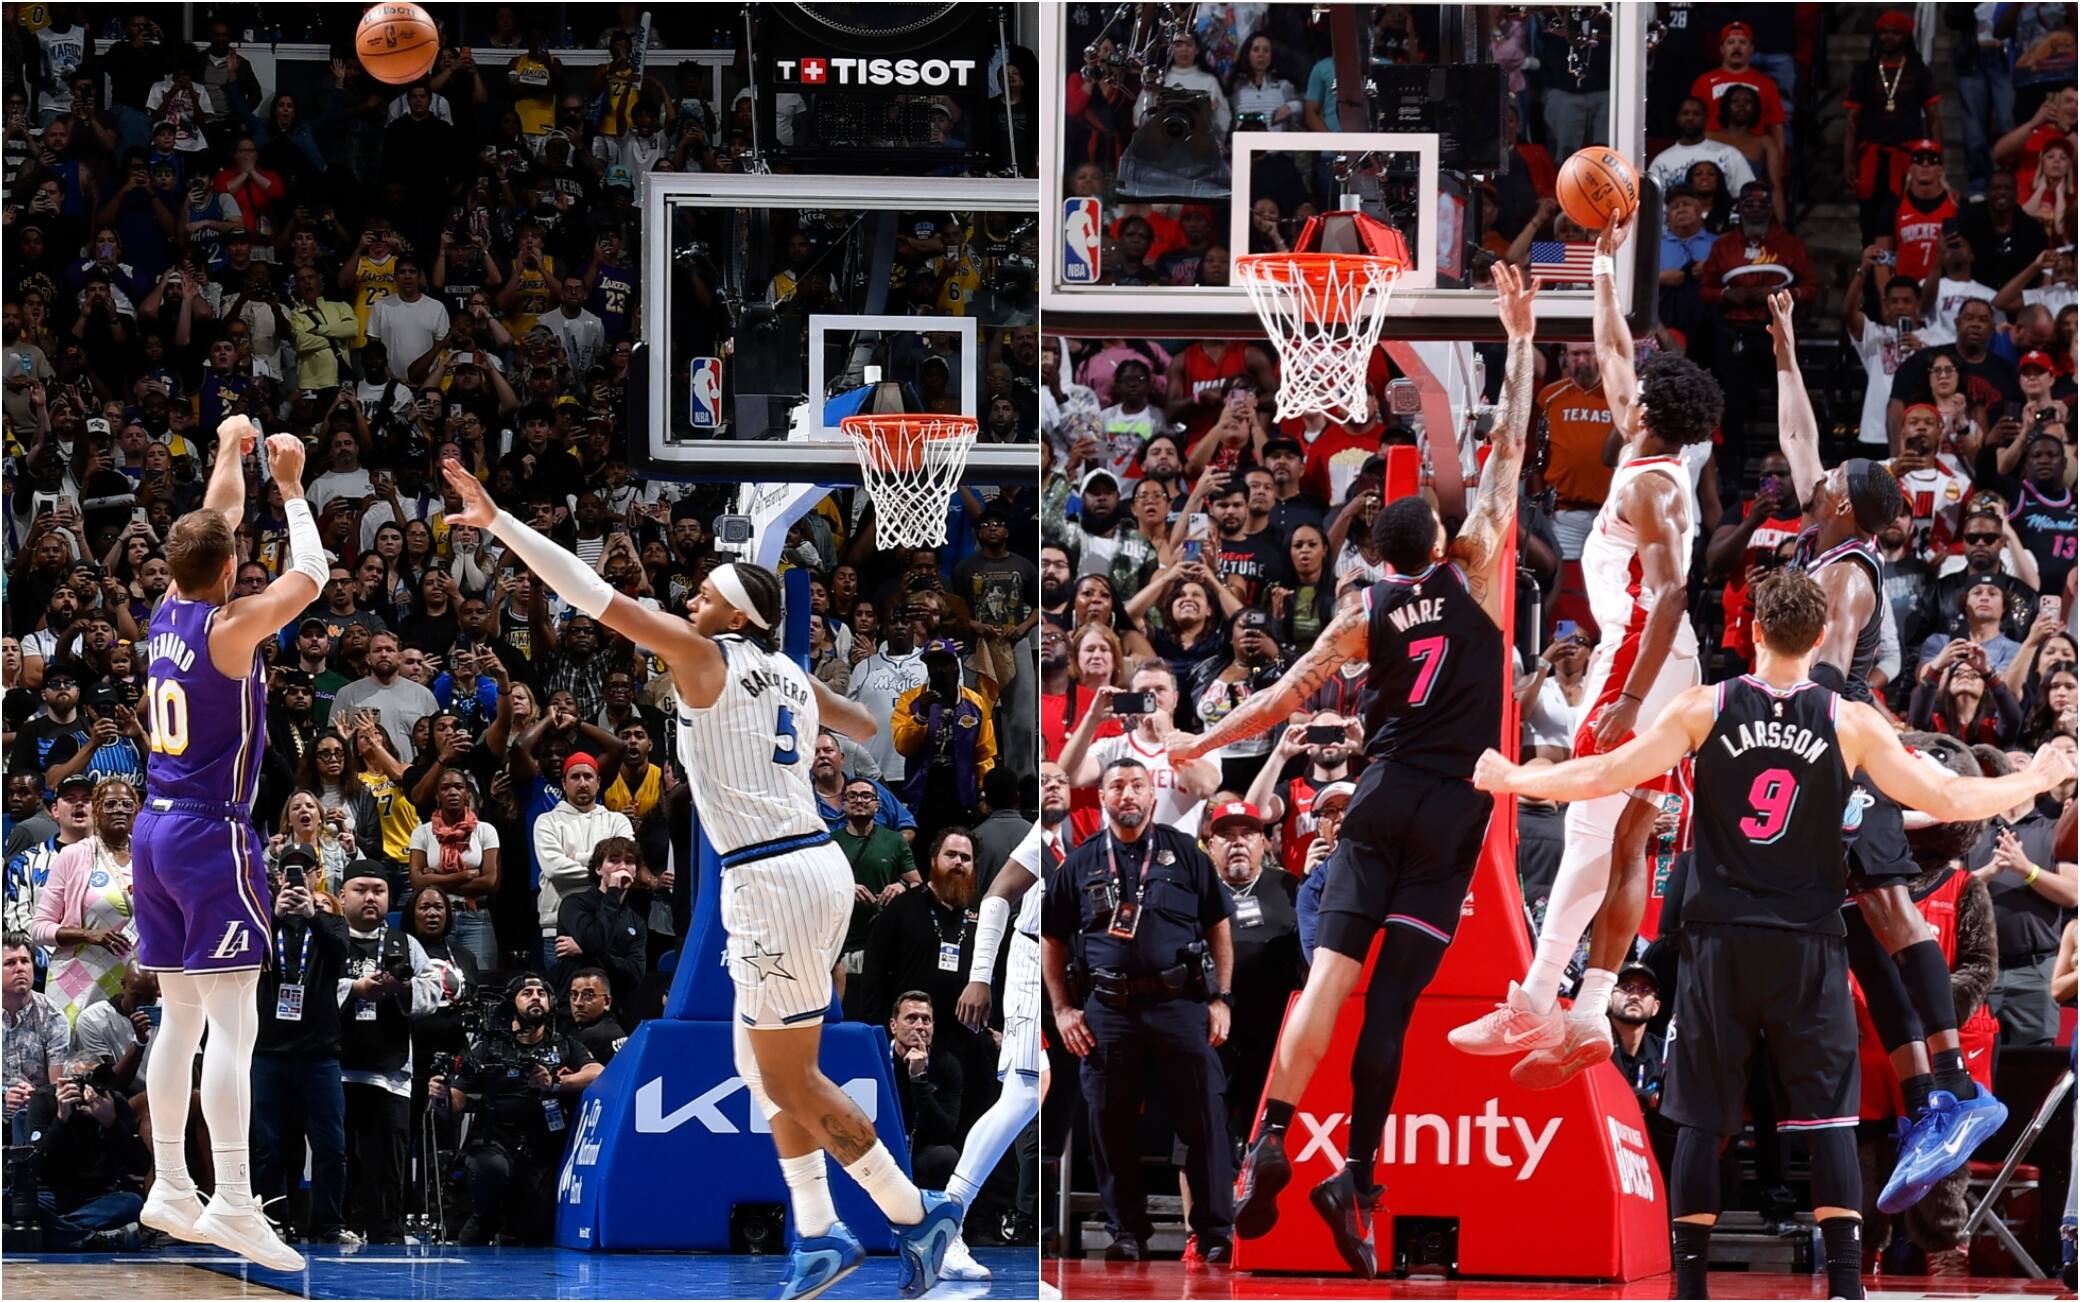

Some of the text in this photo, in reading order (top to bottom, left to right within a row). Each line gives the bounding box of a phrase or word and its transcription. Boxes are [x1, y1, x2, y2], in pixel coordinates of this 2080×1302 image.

[1669, 9, 1688, 29] 28
[831, 58, 976, 86] TISSOT
[1900, 222, 1943, 244] ROCKET
[1920, 243, 1932, 267] 7
[1067, 262, 1086, 279] NBA
[522, 295, 548, 315] 23
[949, 282, 961, 301] 6
[693, 410, 711, 424] NBA
[1562, 408, 1612, 425] TEXAS
[2051, 532, 2078, 559] 13
[1218, 559, 1265, 579] LTURE
[1387, 597, 1446, 633] WARE
[1407, 635, 1450, 708] 7
[741, 669, 808, 706] BAERO
[147, 676, 189, 756] 10
[772, 704, 800, 765] 5
[1720, 720, 1829, 765] LARSSON
[1739, 768, 1800, 846] 9
[1295, 1097, 1564, 1181] xinity
